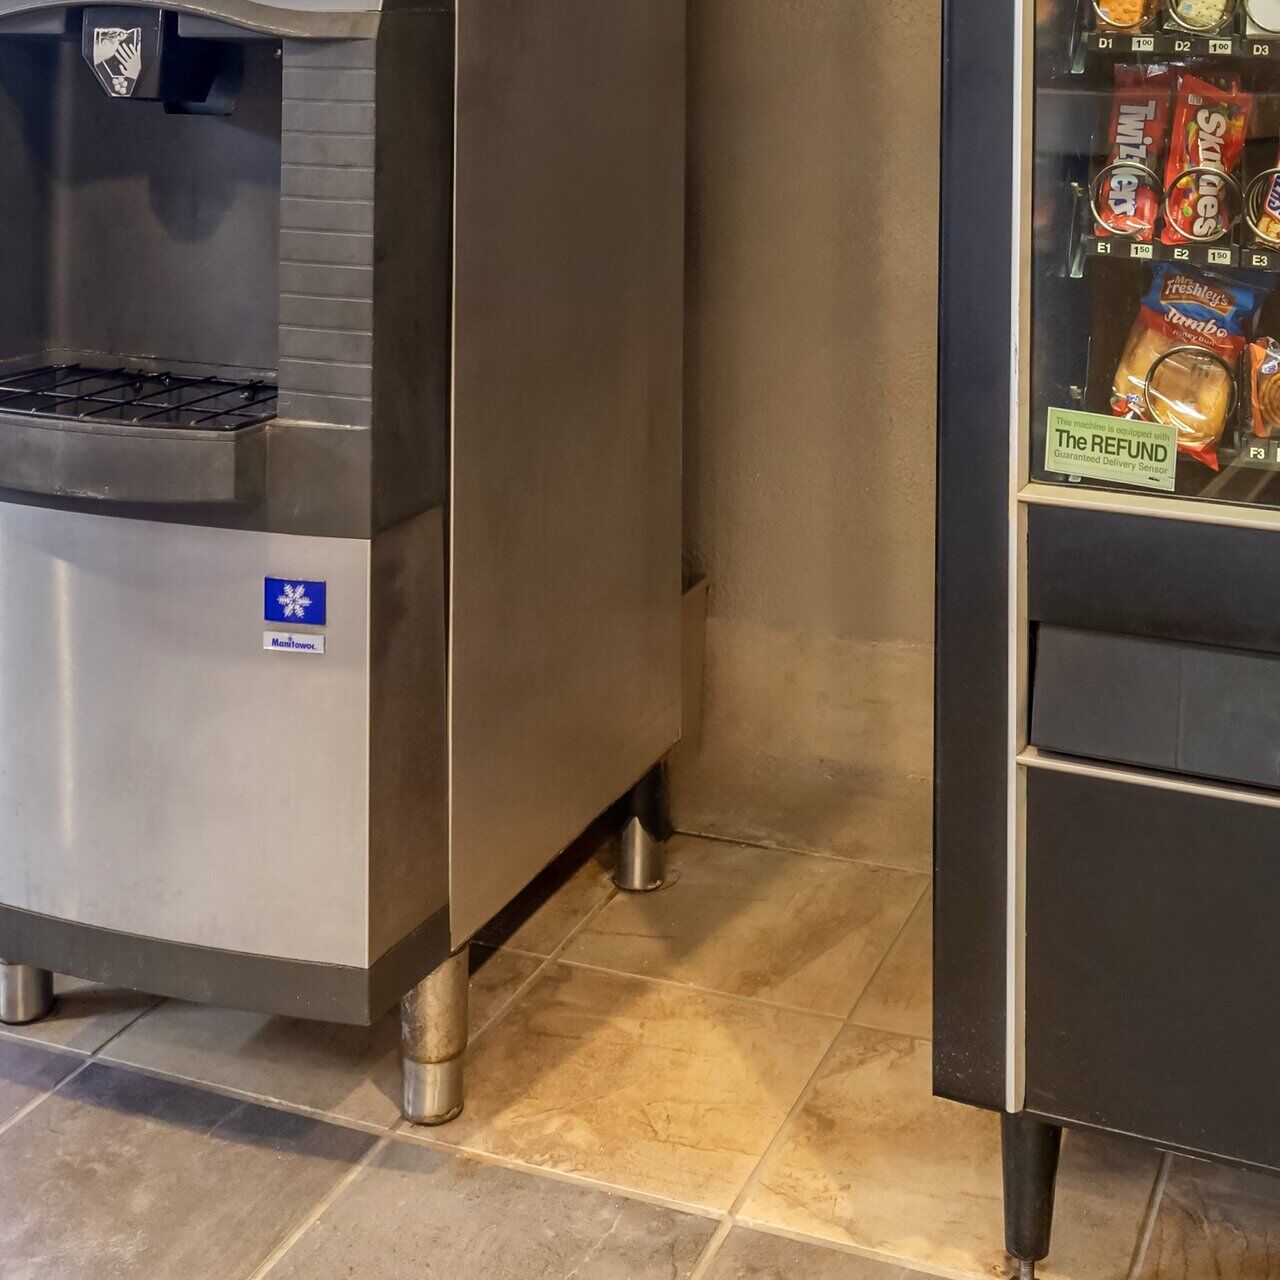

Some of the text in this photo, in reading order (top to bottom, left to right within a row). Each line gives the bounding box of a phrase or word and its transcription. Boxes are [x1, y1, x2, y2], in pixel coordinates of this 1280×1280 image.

[1099, 38, 1113, 49] D1
[1174, 40, 1191, 52] D2
[1252, 44, 1269, 55] D3
[1097, 242, 1111, 253] E1
[1173, 249, 1189, 260] E2
[1252, 255, 1268, 267] E3
[1165, 279, 1229, 308] Freshley's
[1164, 306, 1228, 339] Jumbo
[1198, 336, 1216, 347] Bun
[1056, 416, 1170, 442] This machine is equipped with
[1055, 428, 1168, 464] The REFUND
[1250, 447, 1266, 459] F3
[1053, 448, 1169, 475] Guaranteed Delivery Sensor
[271, 637, 317, 651] Manitowoc
